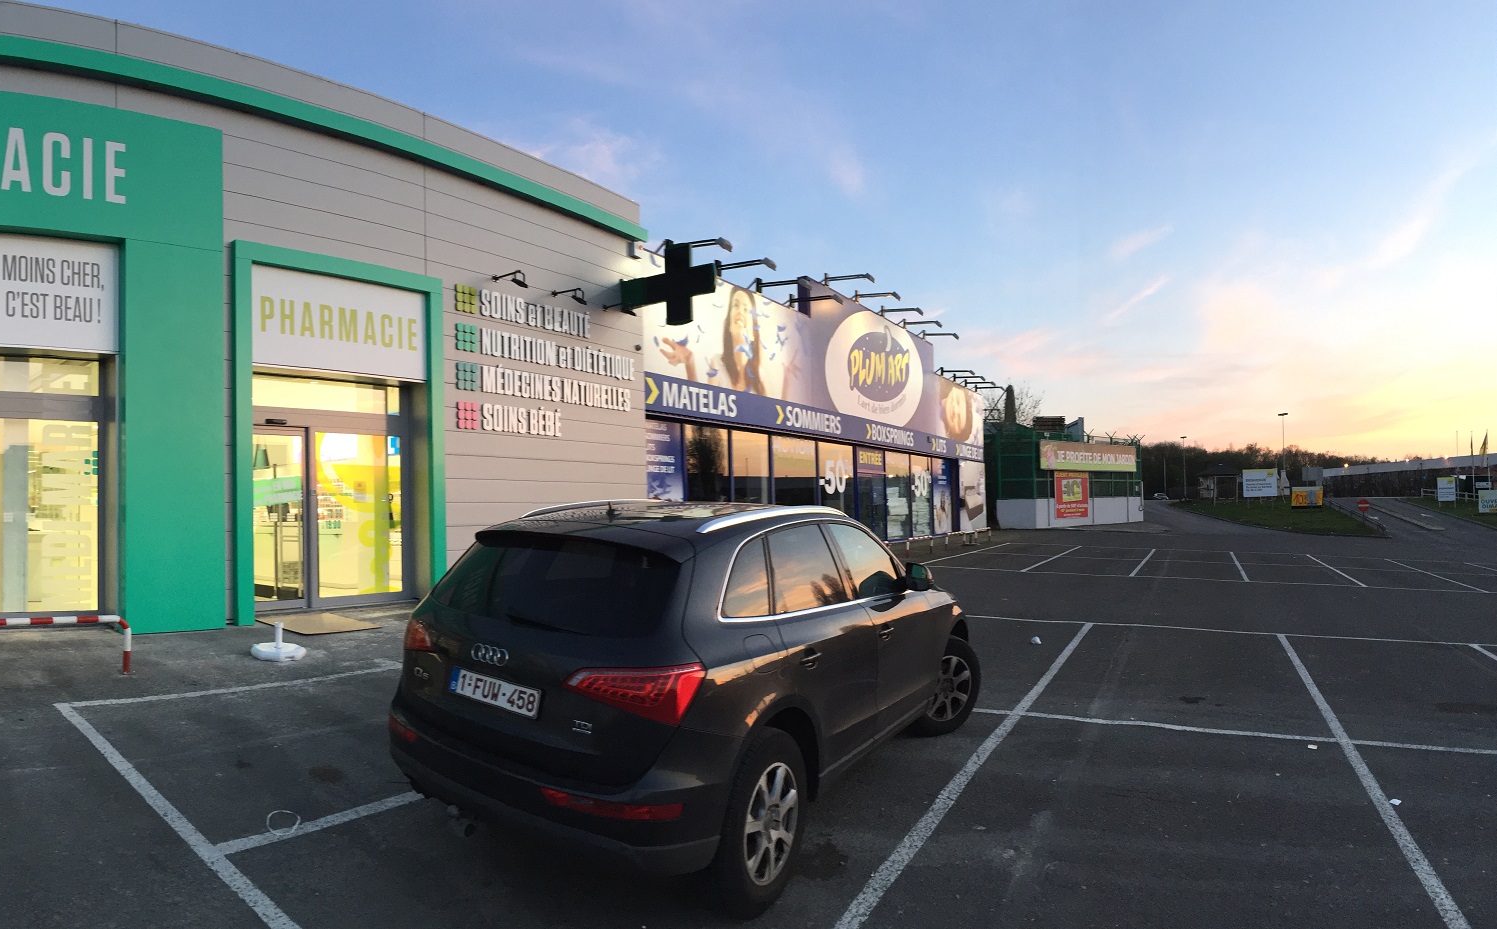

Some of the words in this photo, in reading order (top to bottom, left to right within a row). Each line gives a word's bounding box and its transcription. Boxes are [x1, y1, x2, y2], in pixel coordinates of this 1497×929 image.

[2, 254, 56, 284] MOINS
[60, 259, 105, 292] CHER,
[5, 290, 49, 320] C'EST
[53, 294, 93, 323] BEAU
[260, 295, 418, 352] PHARMACIE
[480, 289, 525, 324] SOINS
[528, 303, 542, 327] et
[544, 304, 591, 339] BEAUTÉ
[480, 328, 557, 367] NUTRITION
[559, 346, 572, 369] et
[574, 346, 635, 381] DIÉTÉTIQUE
[849, 348, 886, 391] PLUM
[887, 348, 909, 387] ART
[481, 363, 563, 402] MÉDECINES
[563, 378, 631, 412] NATURELLES
[481, 403, 528, 434] SOINS
[529, 406, 562, 437] BÉBÉ
[662, 381, 738, 418] MATELAS
[785, 405, 842, 435] SOMMIERS
[871, 423, 915, 447] BOXSPRINGS
[935, 439, 947, 453] LITS
[859, 451, 883, 465] ENTRÉE
[1056, 451, 1065, 463] JE
[1066, 451, 1093, 464] PROFITE
[1093, 453, 1101, 464] DE
[1102, 453, 1115, 465] MON
[460, 673, 537, 714] 1-FUW-458
